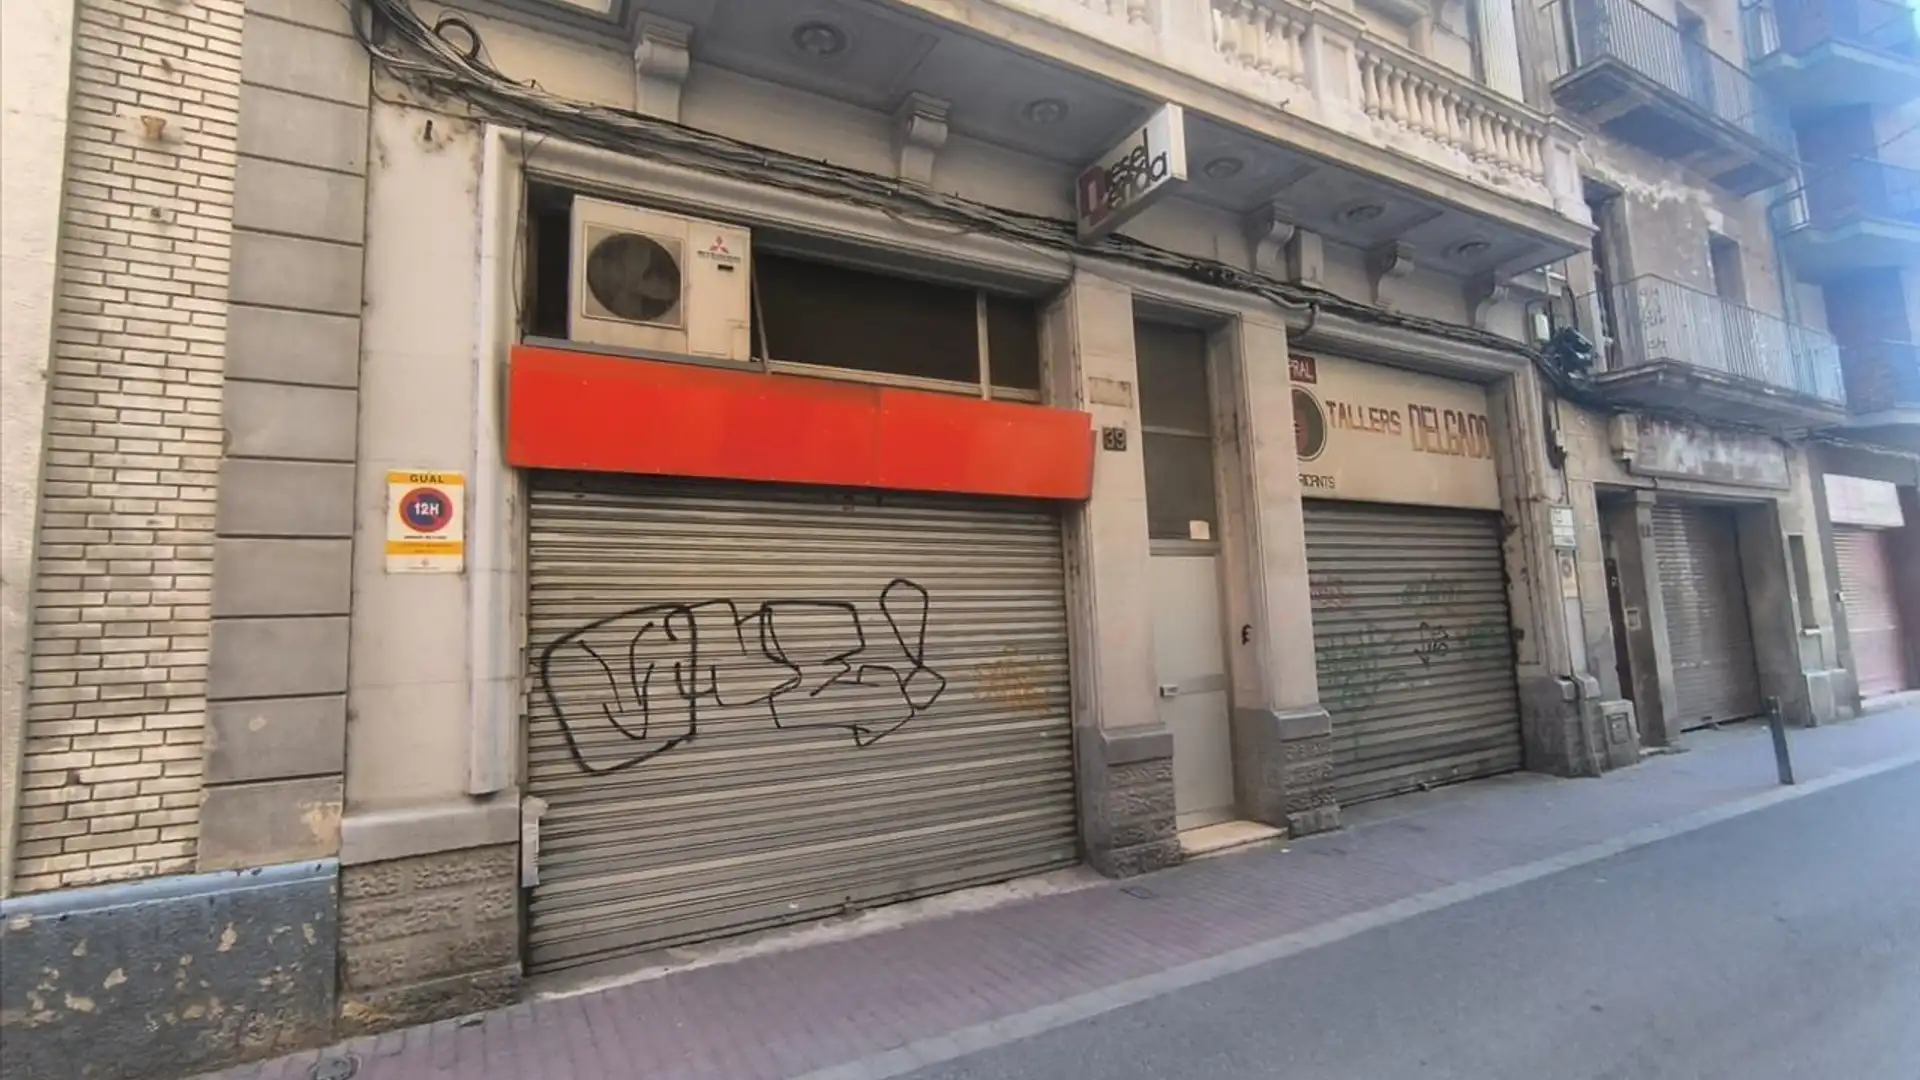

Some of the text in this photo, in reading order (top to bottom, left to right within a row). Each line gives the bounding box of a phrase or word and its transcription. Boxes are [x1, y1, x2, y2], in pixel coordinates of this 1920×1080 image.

[1326, 400, 1492, 459] TALLERS DELGADO
[1105, 429, 1126, 450] 39
[409, 474, 445, 485] GUAL
[414, 502, 440, 516] 12H
